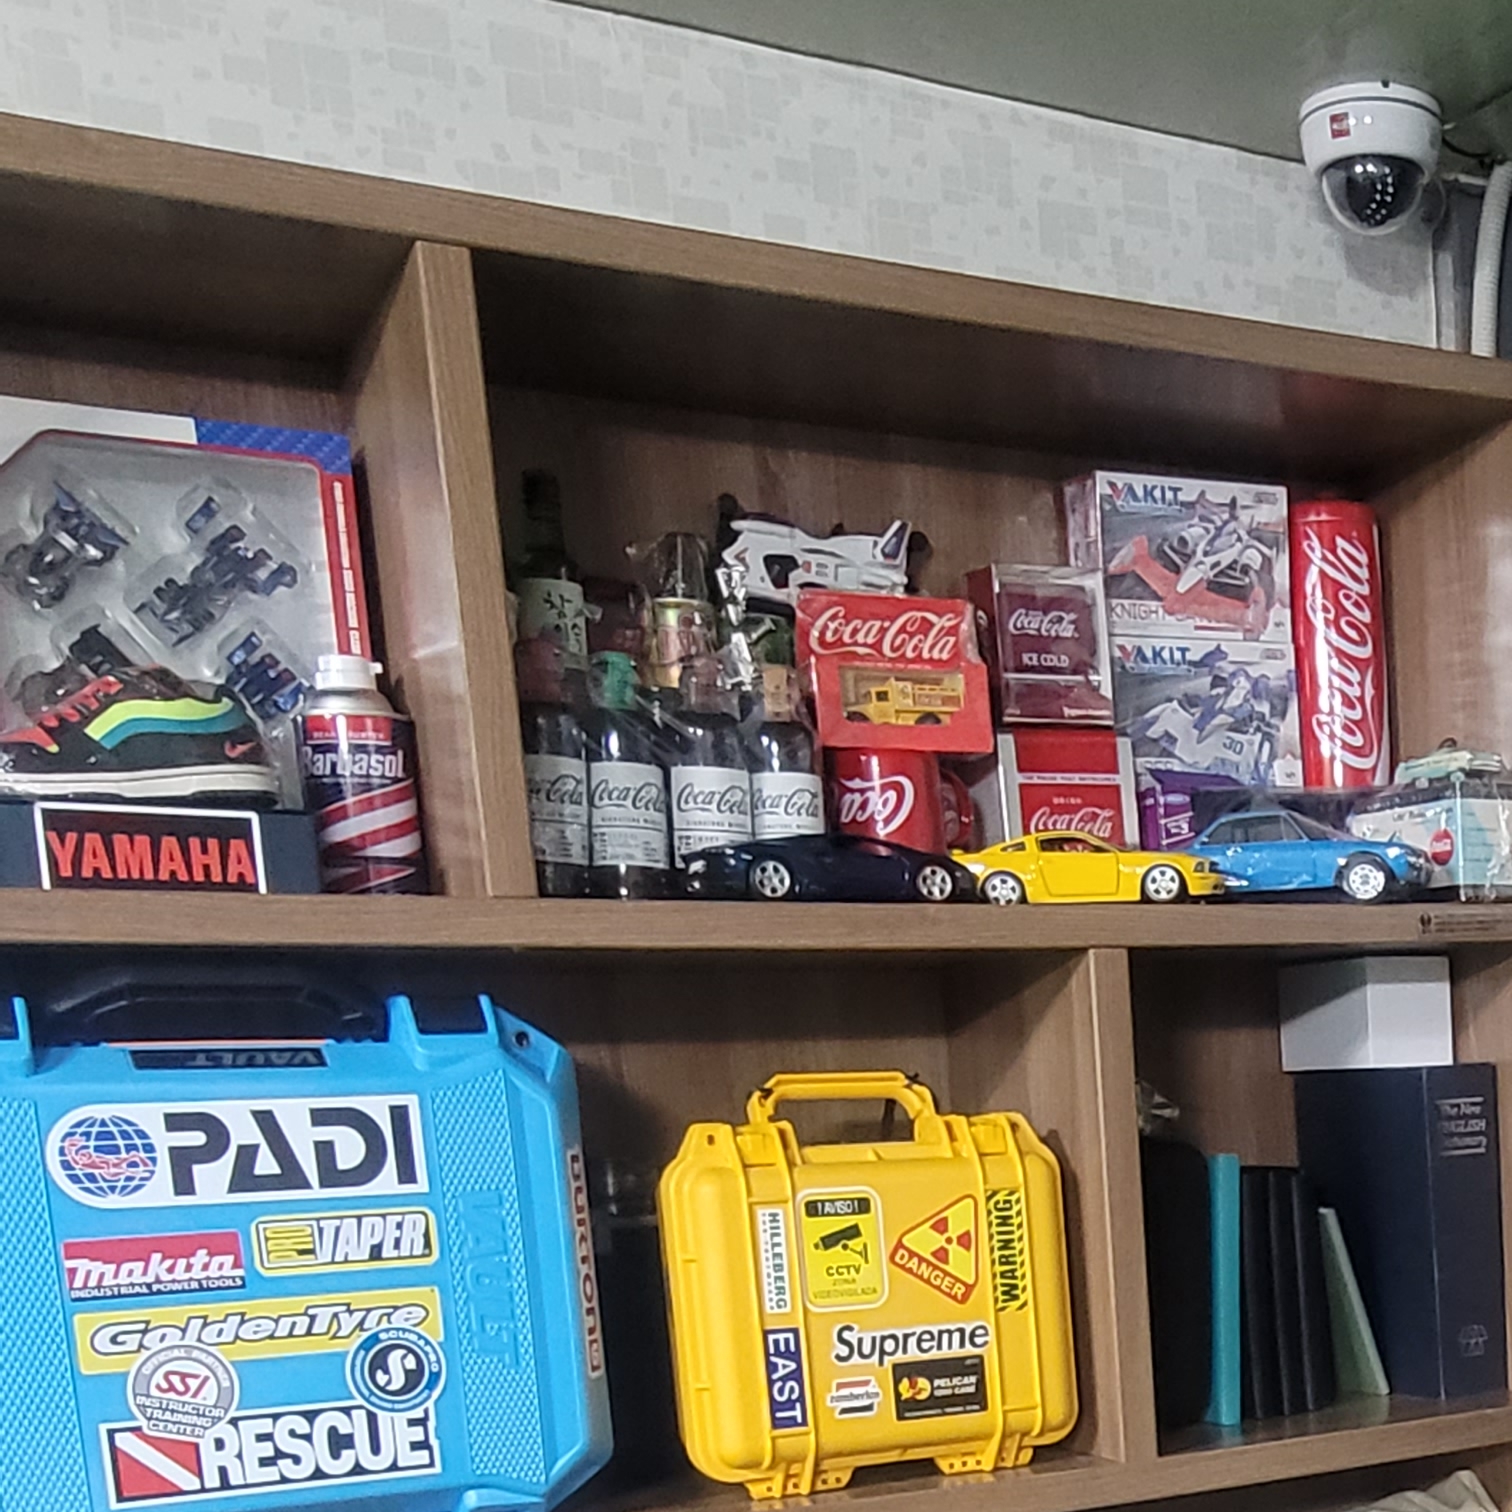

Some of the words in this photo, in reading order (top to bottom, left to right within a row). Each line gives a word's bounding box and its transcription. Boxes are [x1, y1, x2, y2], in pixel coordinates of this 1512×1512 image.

[809, 606, 961, 662] Coca-Cola
[1008, 608, 1080, 638] Coca-Cola
[1021, 652, 1038, 666] ICE
[1040, 653, 1070, 667] COLD
[1223, 737, 1245, 755] 30
[46, 830, 256, 884] YAMAHA
[187, 1051, 320, 1067] VAULT
[164, 1104, 418, 1197] PADI
[319, 1213, 427, 1262] TAPER
[993, 1198, 1019, 1304] WARNING
[65, 1249, 245, 1288] makita
[768, 1212, 788, 1309] HILLEBERG
[826, 1264, 861, 1277] CCTV
[894, 1249, 966, 1301] DANGER
[71, 1284, 149, 1298] INDUSTRIAL
[152, 1281, 199, 1292] POWER
[201, 1277, 243, 1288] TOOLS
[89, 1304, 428, 1355] GoldenTyre
[834, 1324, 989, 1367] Supreme
[378, 1330, 439, 1373] SCUBAPRO
[155, 1370, 211, 1399] SSI
[768, 1332, 803, 1424] EAST
[934, 1375, 979, 1387] PELICAN
[136, 1395, 225, 1417] INSTRUCTOR
[146, 1408, 213, 1427] TRAINING
[149, 1420, 204, 1437] CENTER
[200, 1408, 433, 1489] RESCUE
